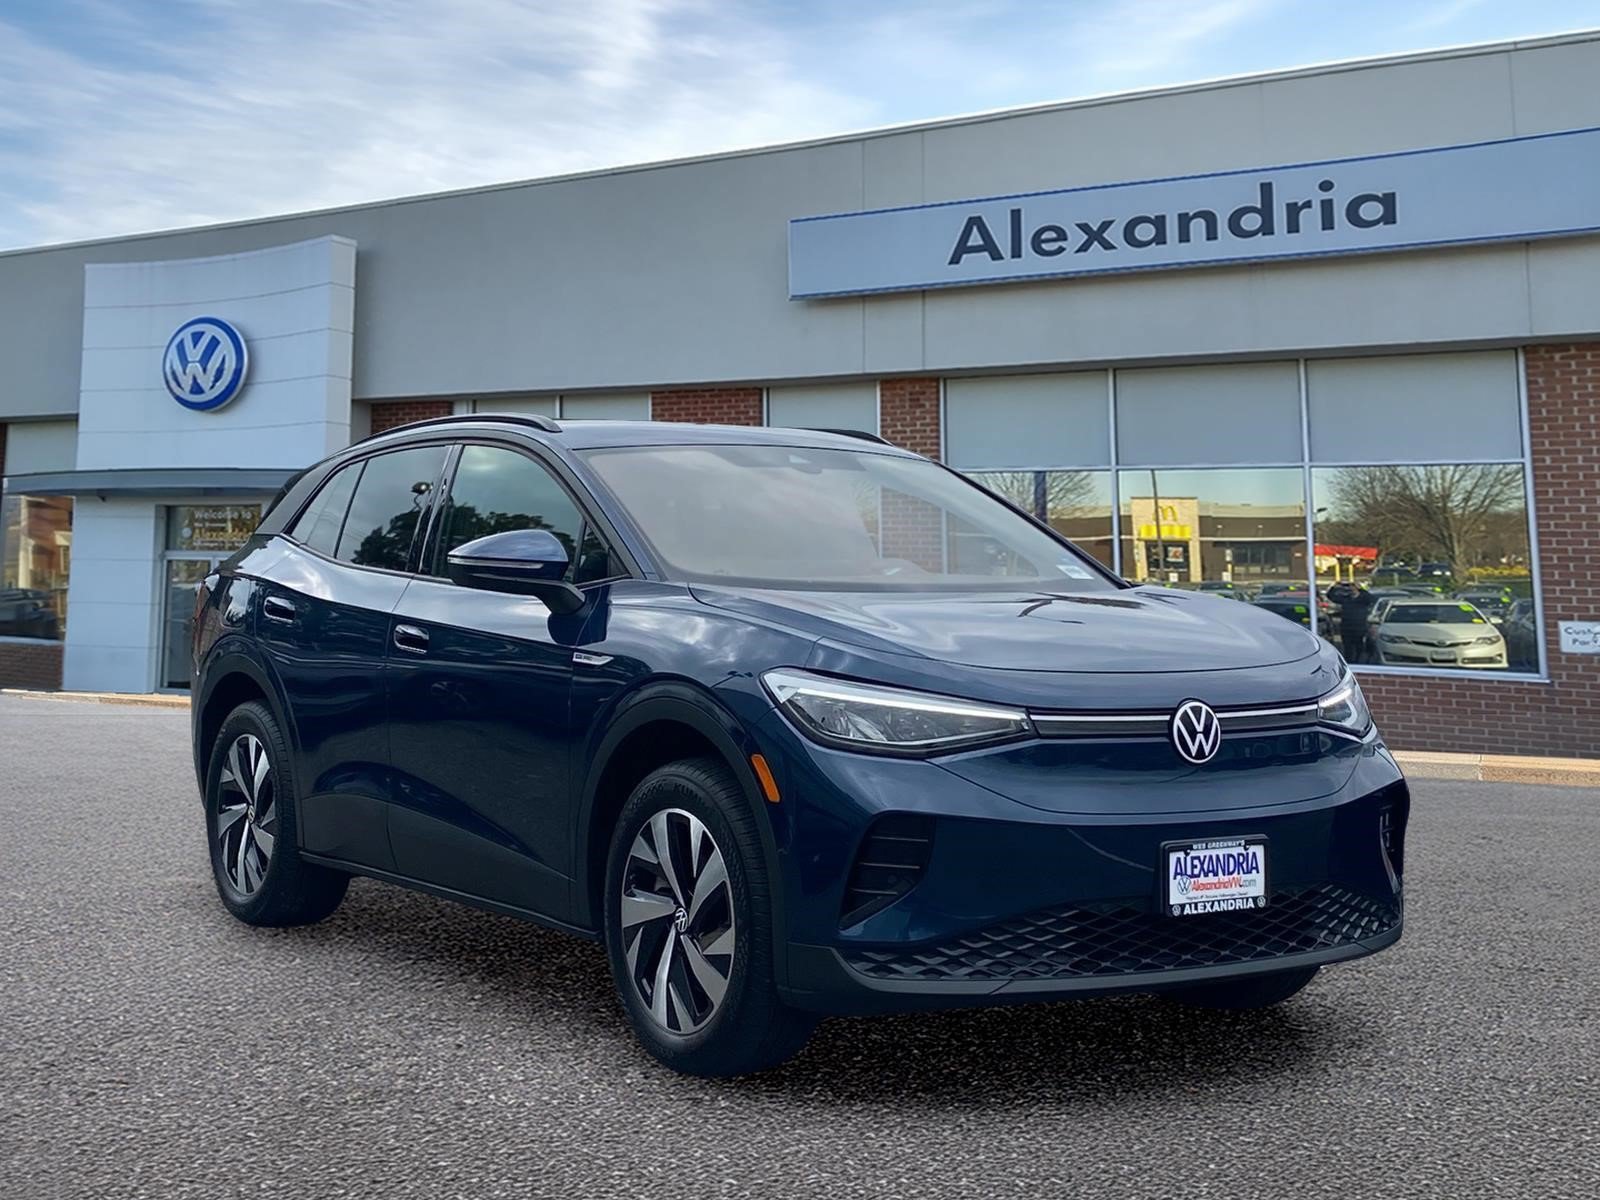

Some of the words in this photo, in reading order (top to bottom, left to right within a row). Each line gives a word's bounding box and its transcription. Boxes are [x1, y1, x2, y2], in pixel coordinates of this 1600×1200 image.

[948, 179, 1397, 266] Alexandria
[164, 318, 242, 408] VW
[194, 509, 239, 519] Welcome
[241, 510, 252, 519] to
[1173, 701, 1221, 764] VW
[1172, 851, 1260, 880] ALEXANDRIA
[1183, 897, 1255, 915] ALEXANDRIA
